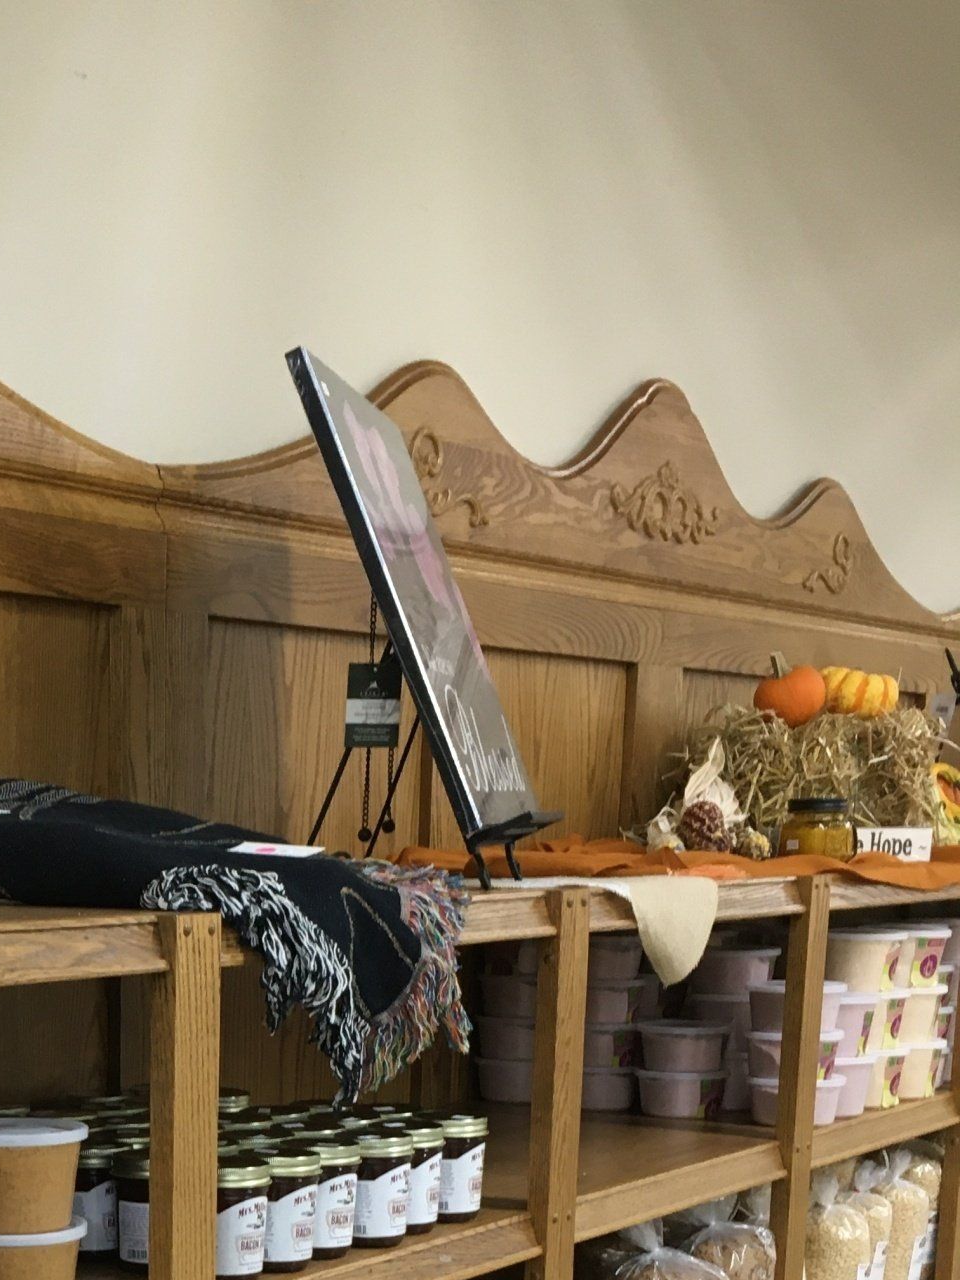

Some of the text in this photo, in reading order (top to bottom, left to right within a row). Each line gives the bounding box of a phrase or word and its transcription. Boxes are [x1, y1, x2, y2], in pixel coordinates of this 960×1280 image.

[445, 685, 526, 792] Blessed
[871, 832, 912, 857] Hope
[330, 1214, 349, 1226] BACON
[240, 1239, 260, 1252] BACON
